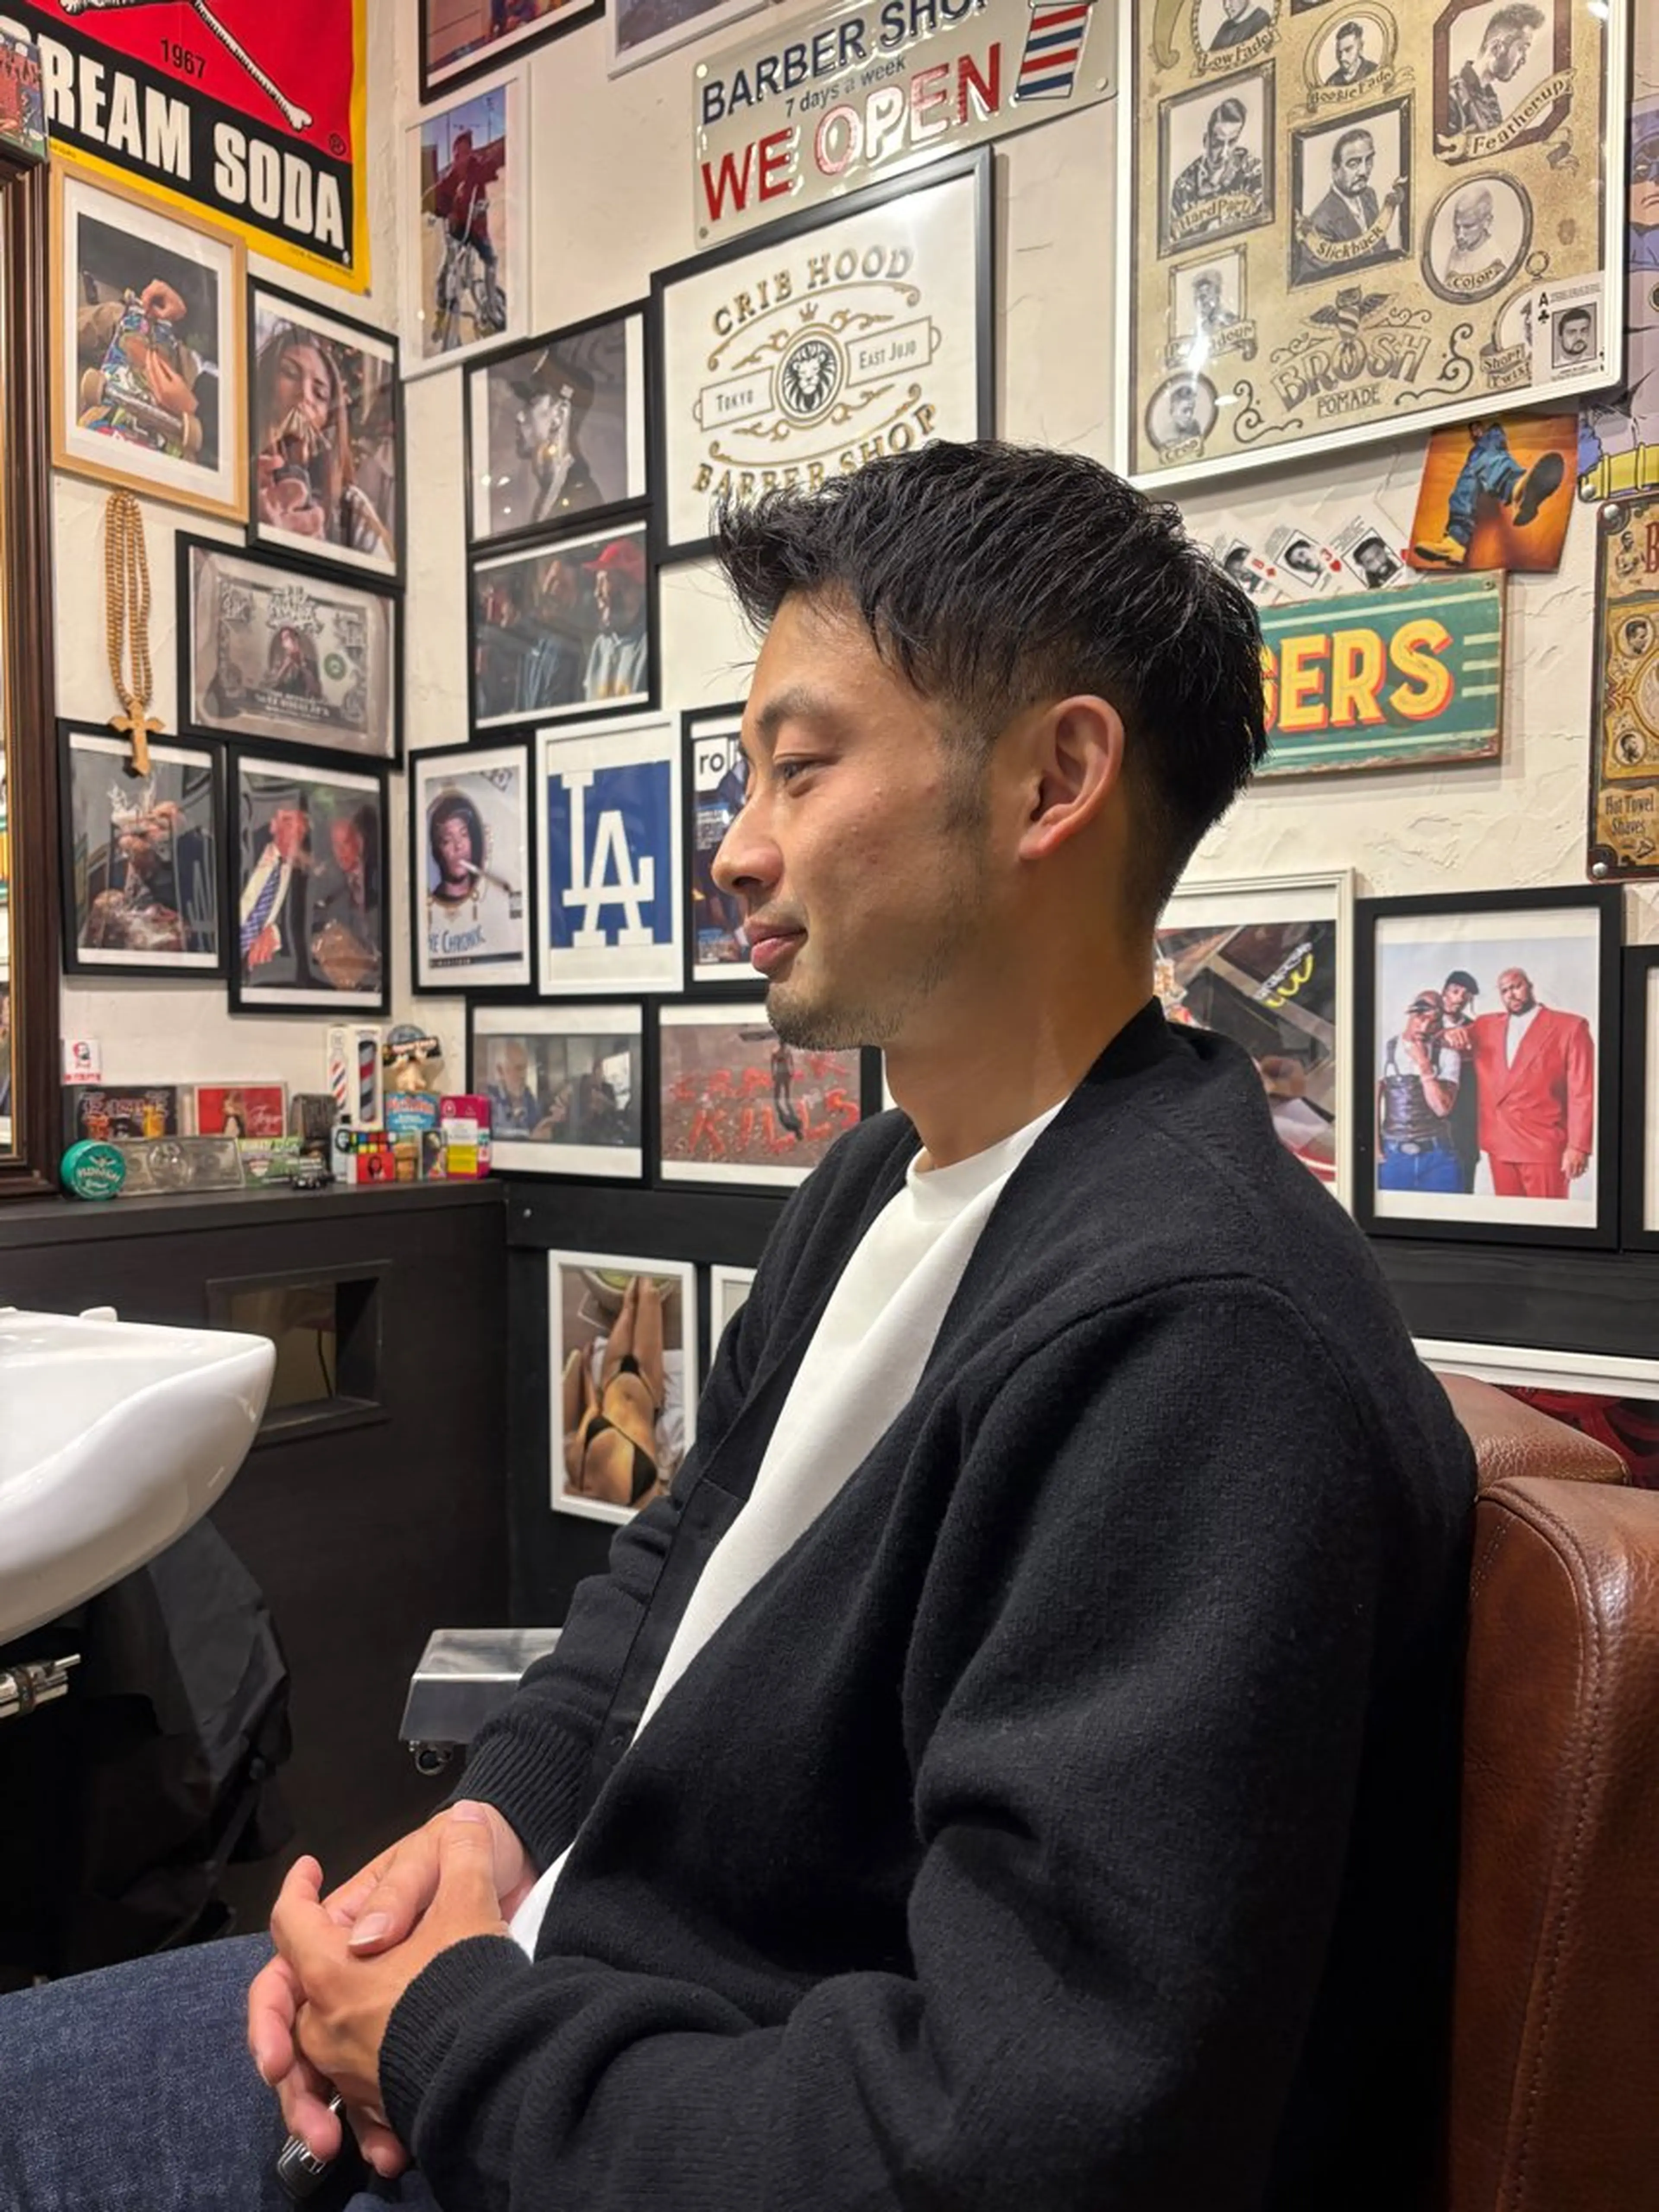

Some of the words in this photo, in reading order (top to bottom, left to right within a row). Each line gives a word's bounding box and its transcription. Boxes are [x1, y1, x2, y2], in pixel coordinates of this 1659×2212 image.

[160, 38, 206, 79] 1967
[703, 18, 867, 125] BARBER
[880, 0, 989, 48] SHO
[785, 99, 795, 118] 7
[800, 81, 840, 114] days
[844, 79, 855, 95] a
[860, 55, 906, 86] week
[701, 127, 793, 222] WE
[814, 42, 1001, 175] OPEN
[214, 121, 346, 252] SODA
[1316, 227, 1383, 258] Slickback
[712, 270, 792, 337] CRIB
[807, 245, 914, 289] HOOD
[1538, 292, 1548, 307] A
[859, 350, 886, 370] EAST
[888, 339, 917, 362] JUJO
[1270, 332, 1431, 411] BROSH
[716, 390, 754, 413] TOKYO
[1316, 387, 1382, 419] POMADE
[692, 461, 826, 498] BARBER
[839, 404, 936, 476] SHOP
[562, 769, 655, 949] LA
[689, 1087, 860, 1154] KILLS
